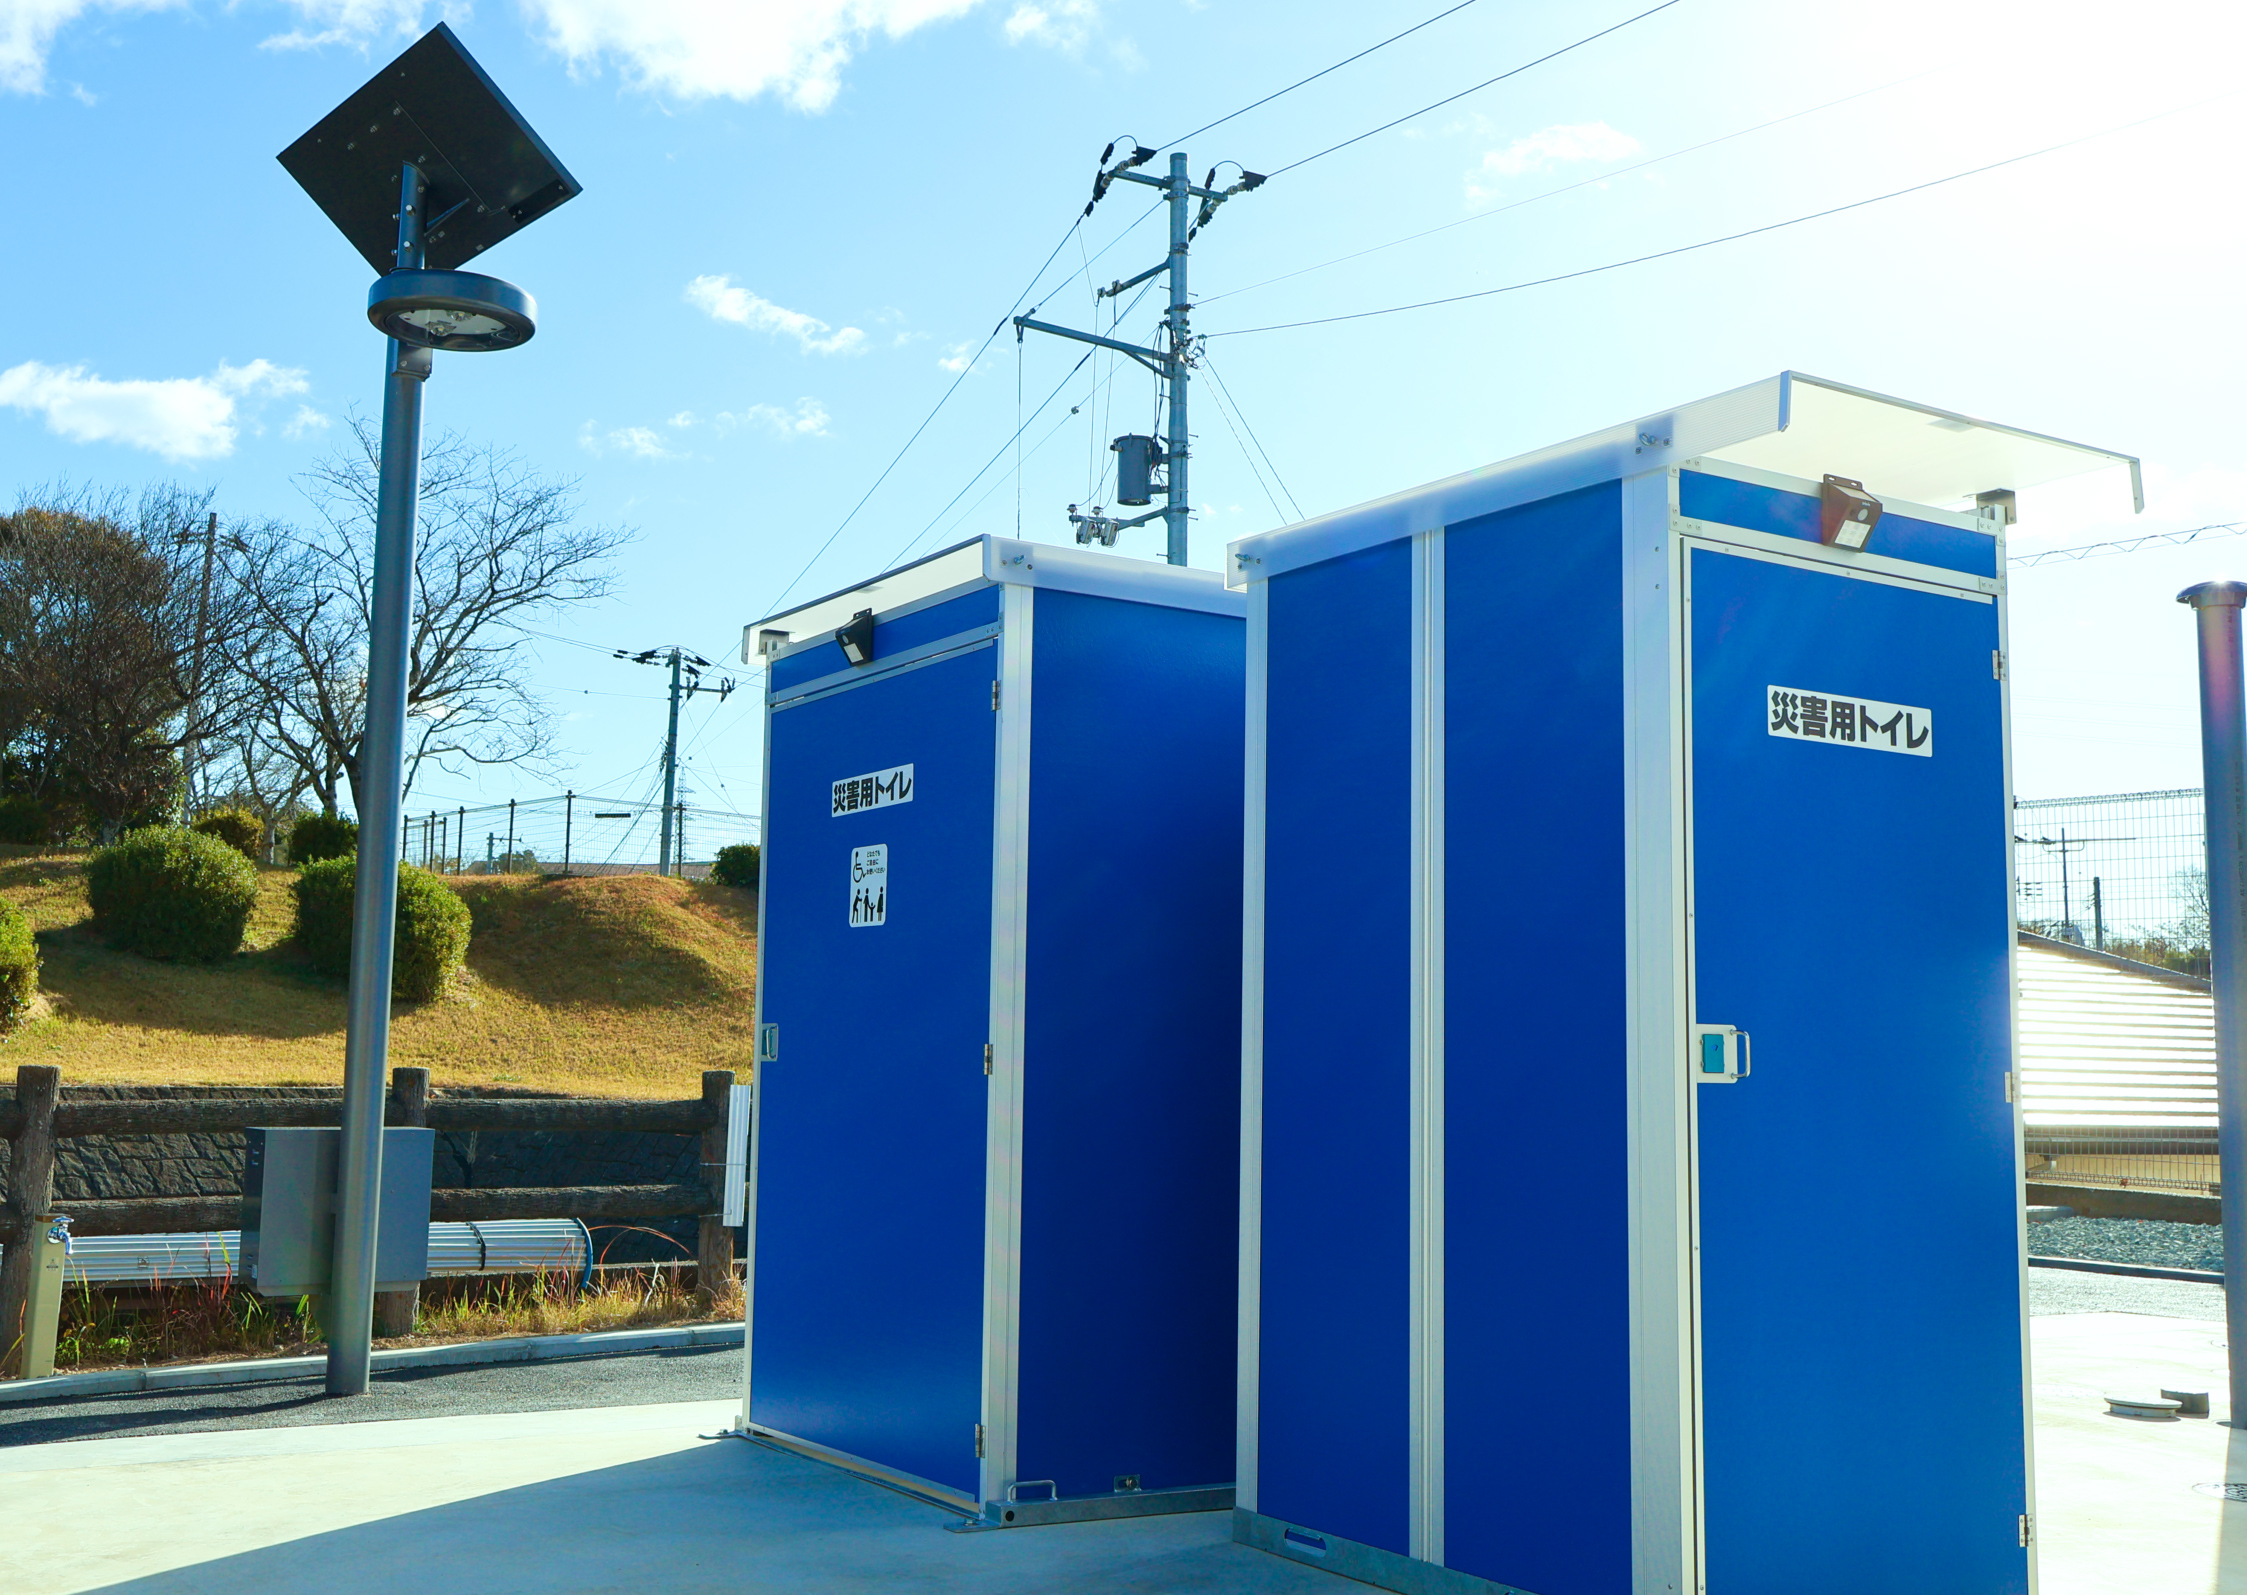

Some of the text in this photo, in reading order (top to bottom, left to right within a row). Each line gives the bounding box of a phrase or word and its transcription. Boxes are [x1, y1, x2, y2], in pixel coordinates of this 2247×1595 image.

[1770, 690, 1930, 749] 災害用トイレ
[833, 770, 912, 814] 災害用トイレ
